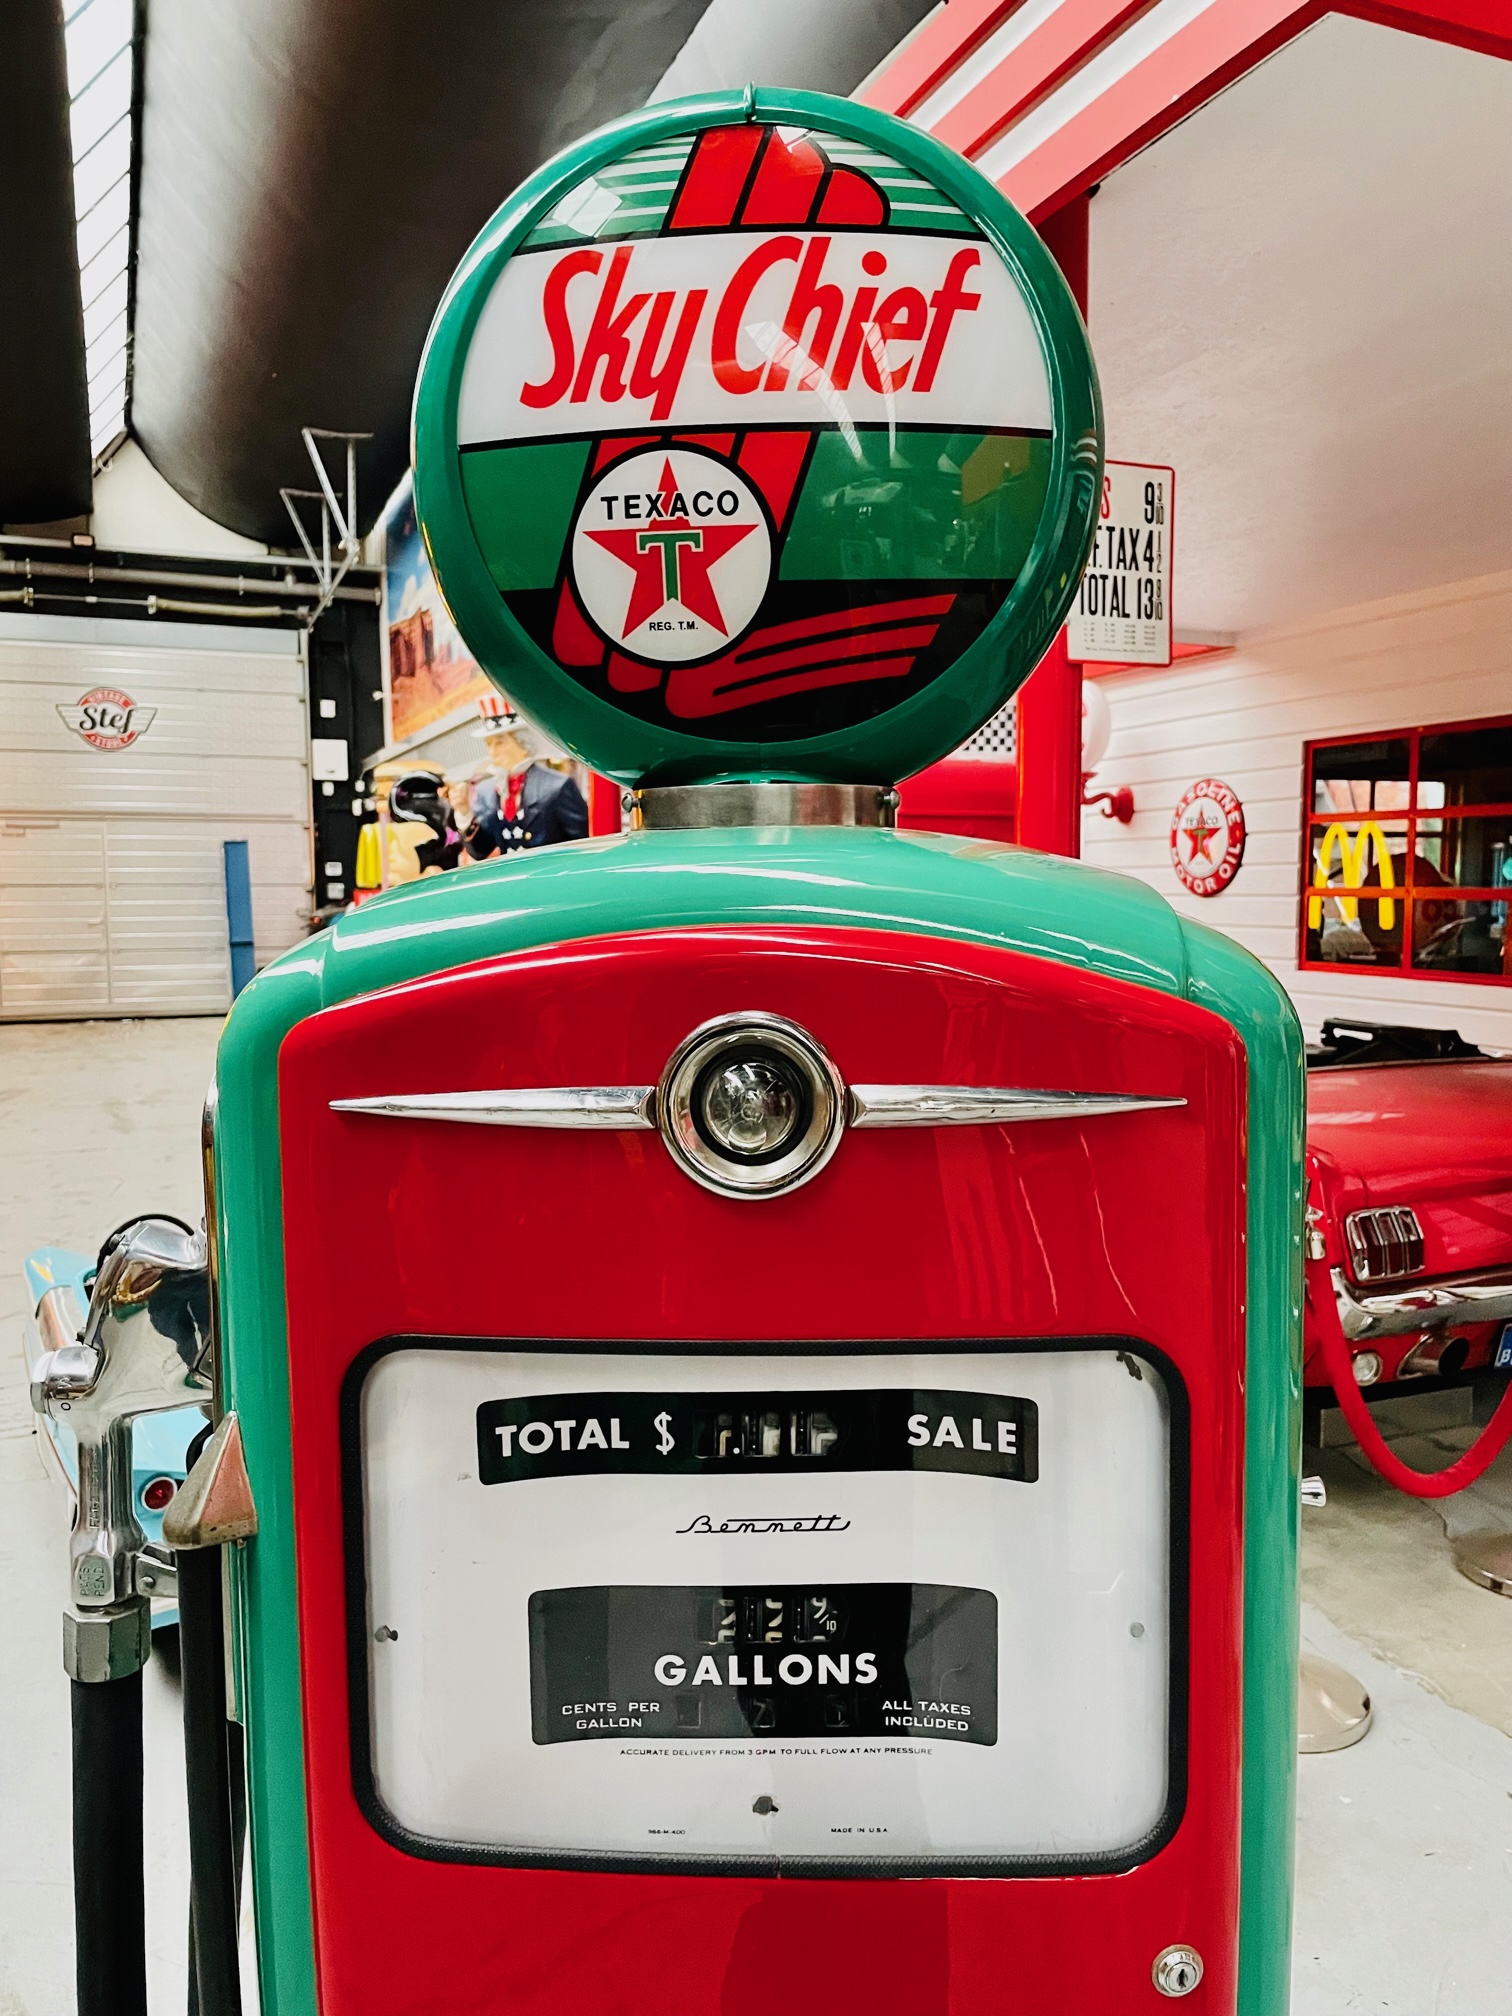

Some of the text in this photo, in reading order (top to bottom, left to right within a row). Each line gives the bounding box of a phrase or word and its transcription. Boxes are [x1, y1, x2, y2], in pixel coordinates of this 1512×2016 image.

[519, 235, 982, 421] Sky Chief
[600, 490, 739, 520] TEXACO
[1144, 481, 1154, 525] 9
[1106, 526, 1140, 571] TAX
[1143, 530, 1154, 573] 4
[1080, 573, 1131, 619] TOTAL
[1137, 577, 1154, 620] 13
[649, 621, 698, 631] REG. T.M.
[79, 707, 135, 734] Stef
[1171, 842, 1242, 893] MOTOR OIL
[495, 1418, 630, 1458] TOTAL
[654, 1411, 675, 1455] $
[907, 1414, 1018, 1456] SALE
[676, 1514, 851, 1533] Bennett
[654, 1652, 879, 1686] GALLONS
[562, 1701, 661, 1715] CENTS PER
[882, 1699, 972, 1716] ALL TAXES
[576, 1716, 643, 1729] GALLON
[884, 1715, 969, 1732] INCLUDED
[620, 1748, 670, 1756] ACCURATE
[672, 1748, 717, 1756] DELIVERY
[719, 1748, 745, 1756] FROM
[747, 1748, 753, 1756] 3
[755, 1748, 777, 1756] GPM
[820, 1747, 847, 1755] FLOW
[849, 1747, 861, 1755] AT
[863, 1747, 882, 1755] ANY
[884, 1747, 933, 1756] PRESSURE
